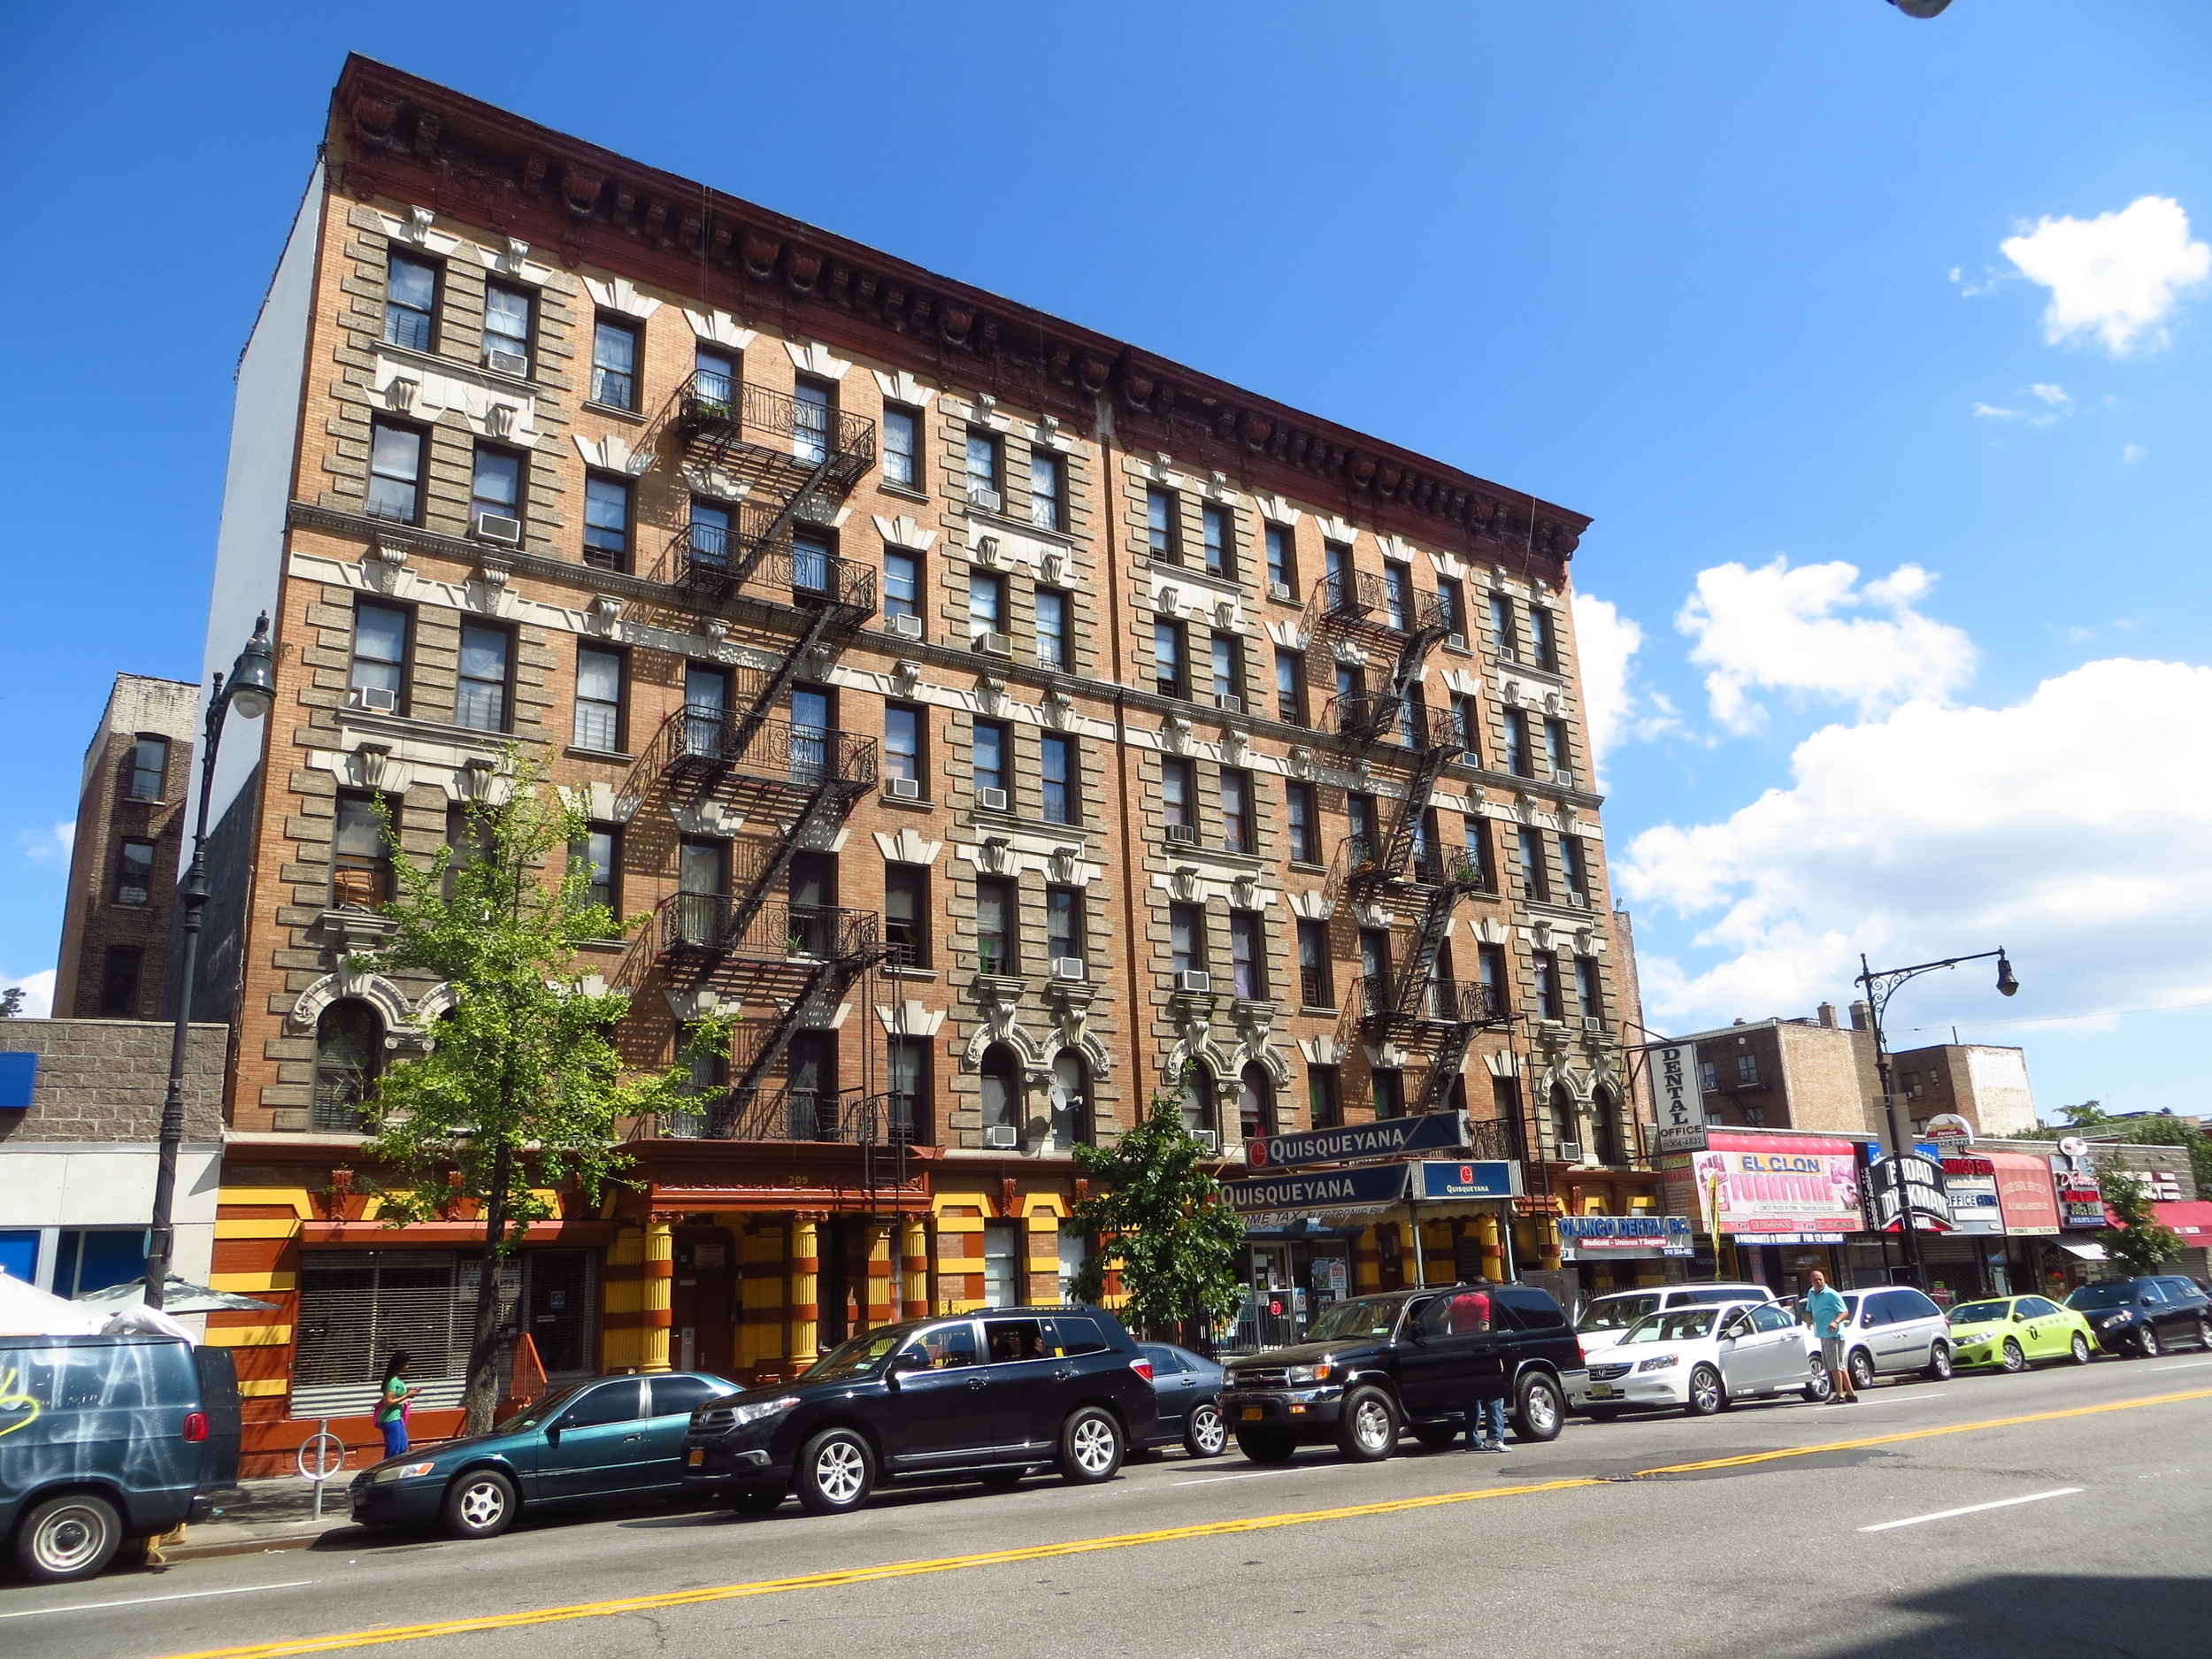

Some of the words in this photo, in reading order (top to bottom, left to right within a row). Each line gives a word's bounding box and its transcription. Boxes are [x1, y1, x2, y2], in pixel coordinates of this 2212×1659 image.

[1662, 1048, 1688, 1125] DENTAL
[1660, 1125, 1702, 1137] OFFICE
[1270, 1128, 1405, 1164] QUISQUEYANA
[1669, 1137, 1701, 1148] 304-4832
[1742, 1156, 1765, 1171] EL
[1769, 1156, 1820, 1172] CLON
[1220, 1179, 1356, 1209] QUISQUEYANA
[1447, 1185, 1489, 1194] QUISQUEYANA
[1730, 1174, 1835, 1202] FURNITURE
[1881, 1184, 1950, 1219] DYKMAN
[1276, 1211, 1302, 1223] TAX
[1618, 1218, 1666, 1236] DENTAL
[1582, 1238, 1609, 1247] Medicaid
[1615, 1238, 1638, 1247] Uniones
[1643, 1238, 1666, 1247] Seguros
[1740, 1233, 1770, 1243] PAYMENTS
[1775, 1233, 1801, 1243] INTEREST
[1802, 1233, 1815, 1243] FOR
[1822, 1233, 1844, 1242] MONTHS
